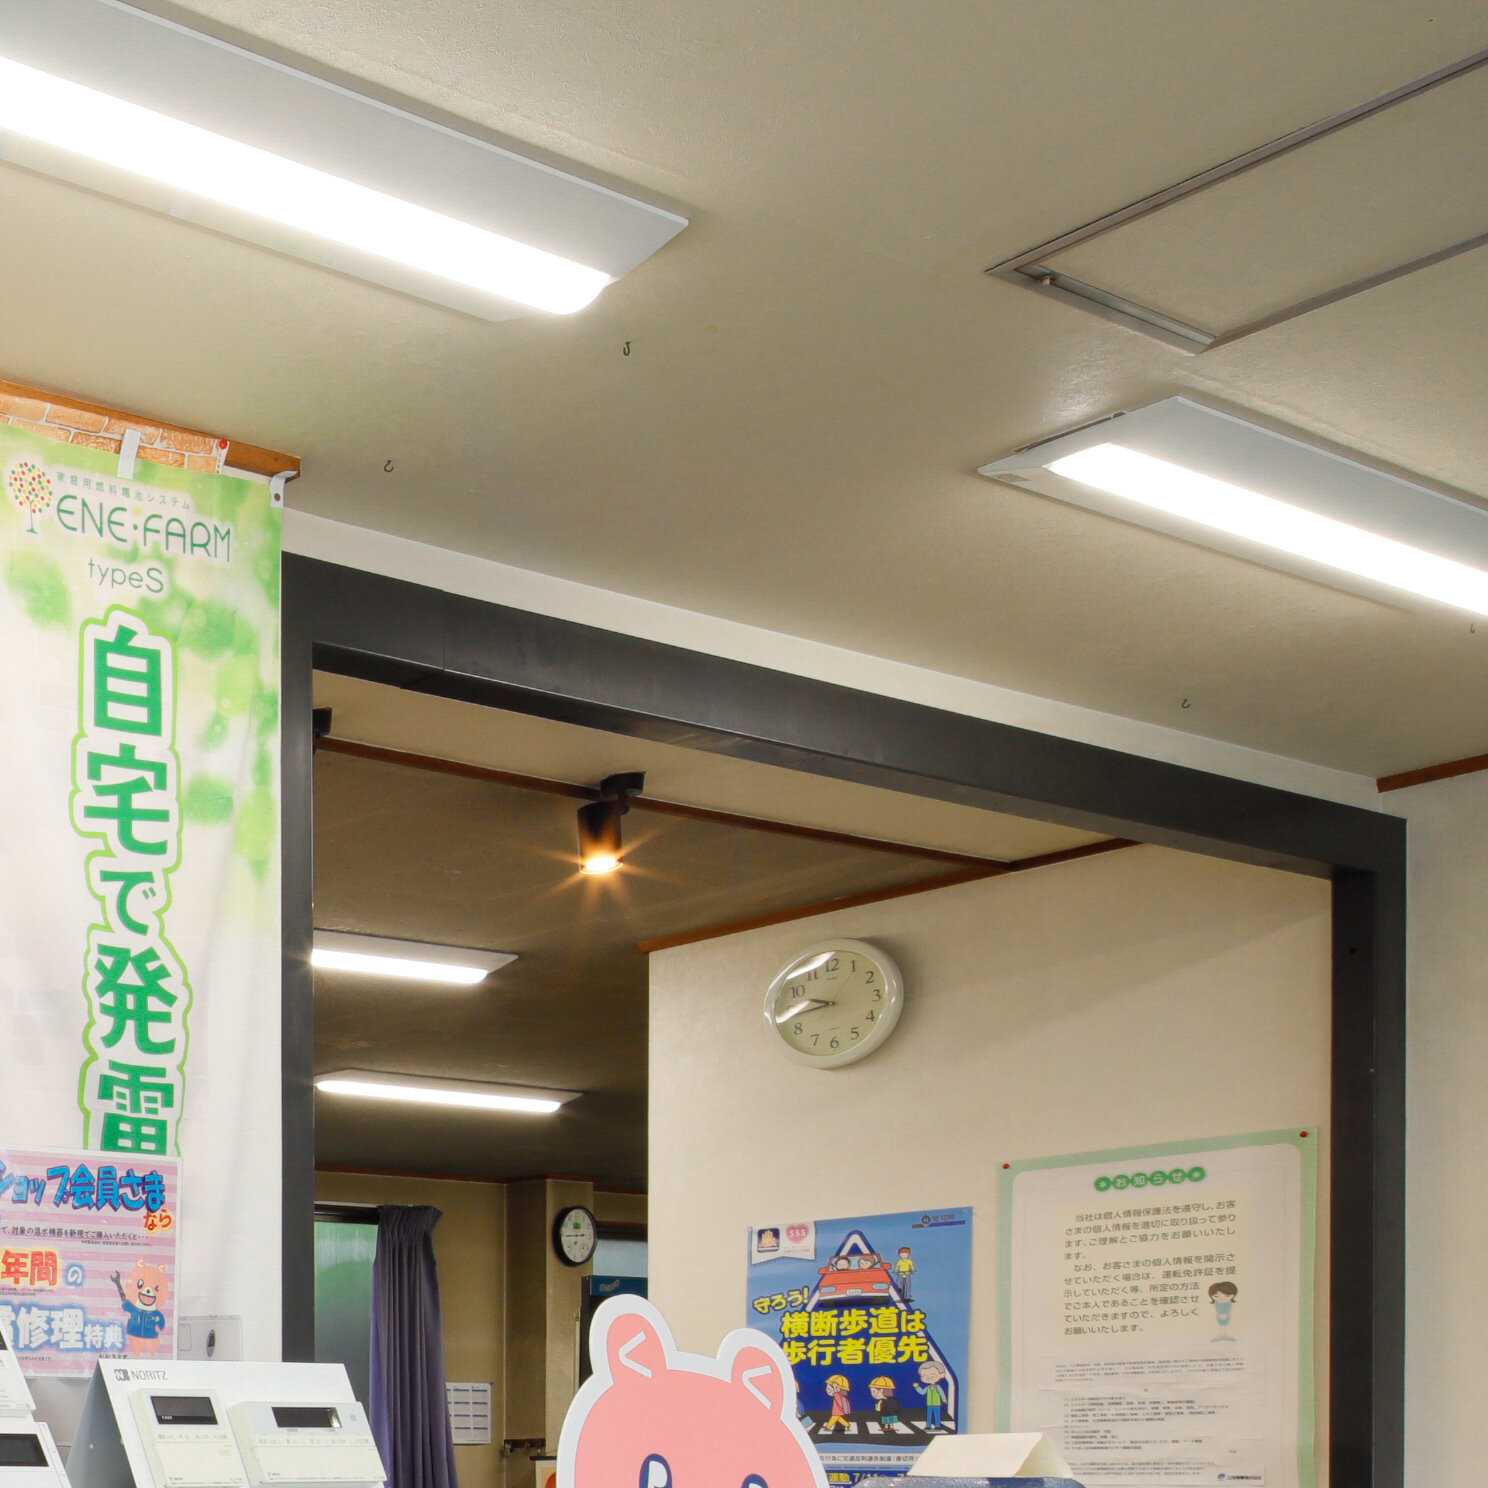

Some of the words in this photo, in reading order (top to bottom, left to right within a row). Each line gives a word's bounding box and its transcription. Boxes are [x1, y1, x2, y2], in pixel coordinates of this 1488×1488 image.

[87, 555, 165, 596] typeS
[825, 958, 839, 972] 12
[865, 971, 874, 984] 2
[872, 989, 881, 1002] 3
[1115, 1170, 1184, 1188] お知らせ
[144, 1211, 173, 1232] なら
[67, 1267, 82, 1283] の
[753, 1287, 810, 1314] 守ろう!
[781, 1307, 926, 1338] 横断歩道は
[1064, 1324, 1144, 1336] お願いいたします。
[782, 1337, 929, 1366] 歩行者優先
[130, 1370, 168, 1380] NORITZ
